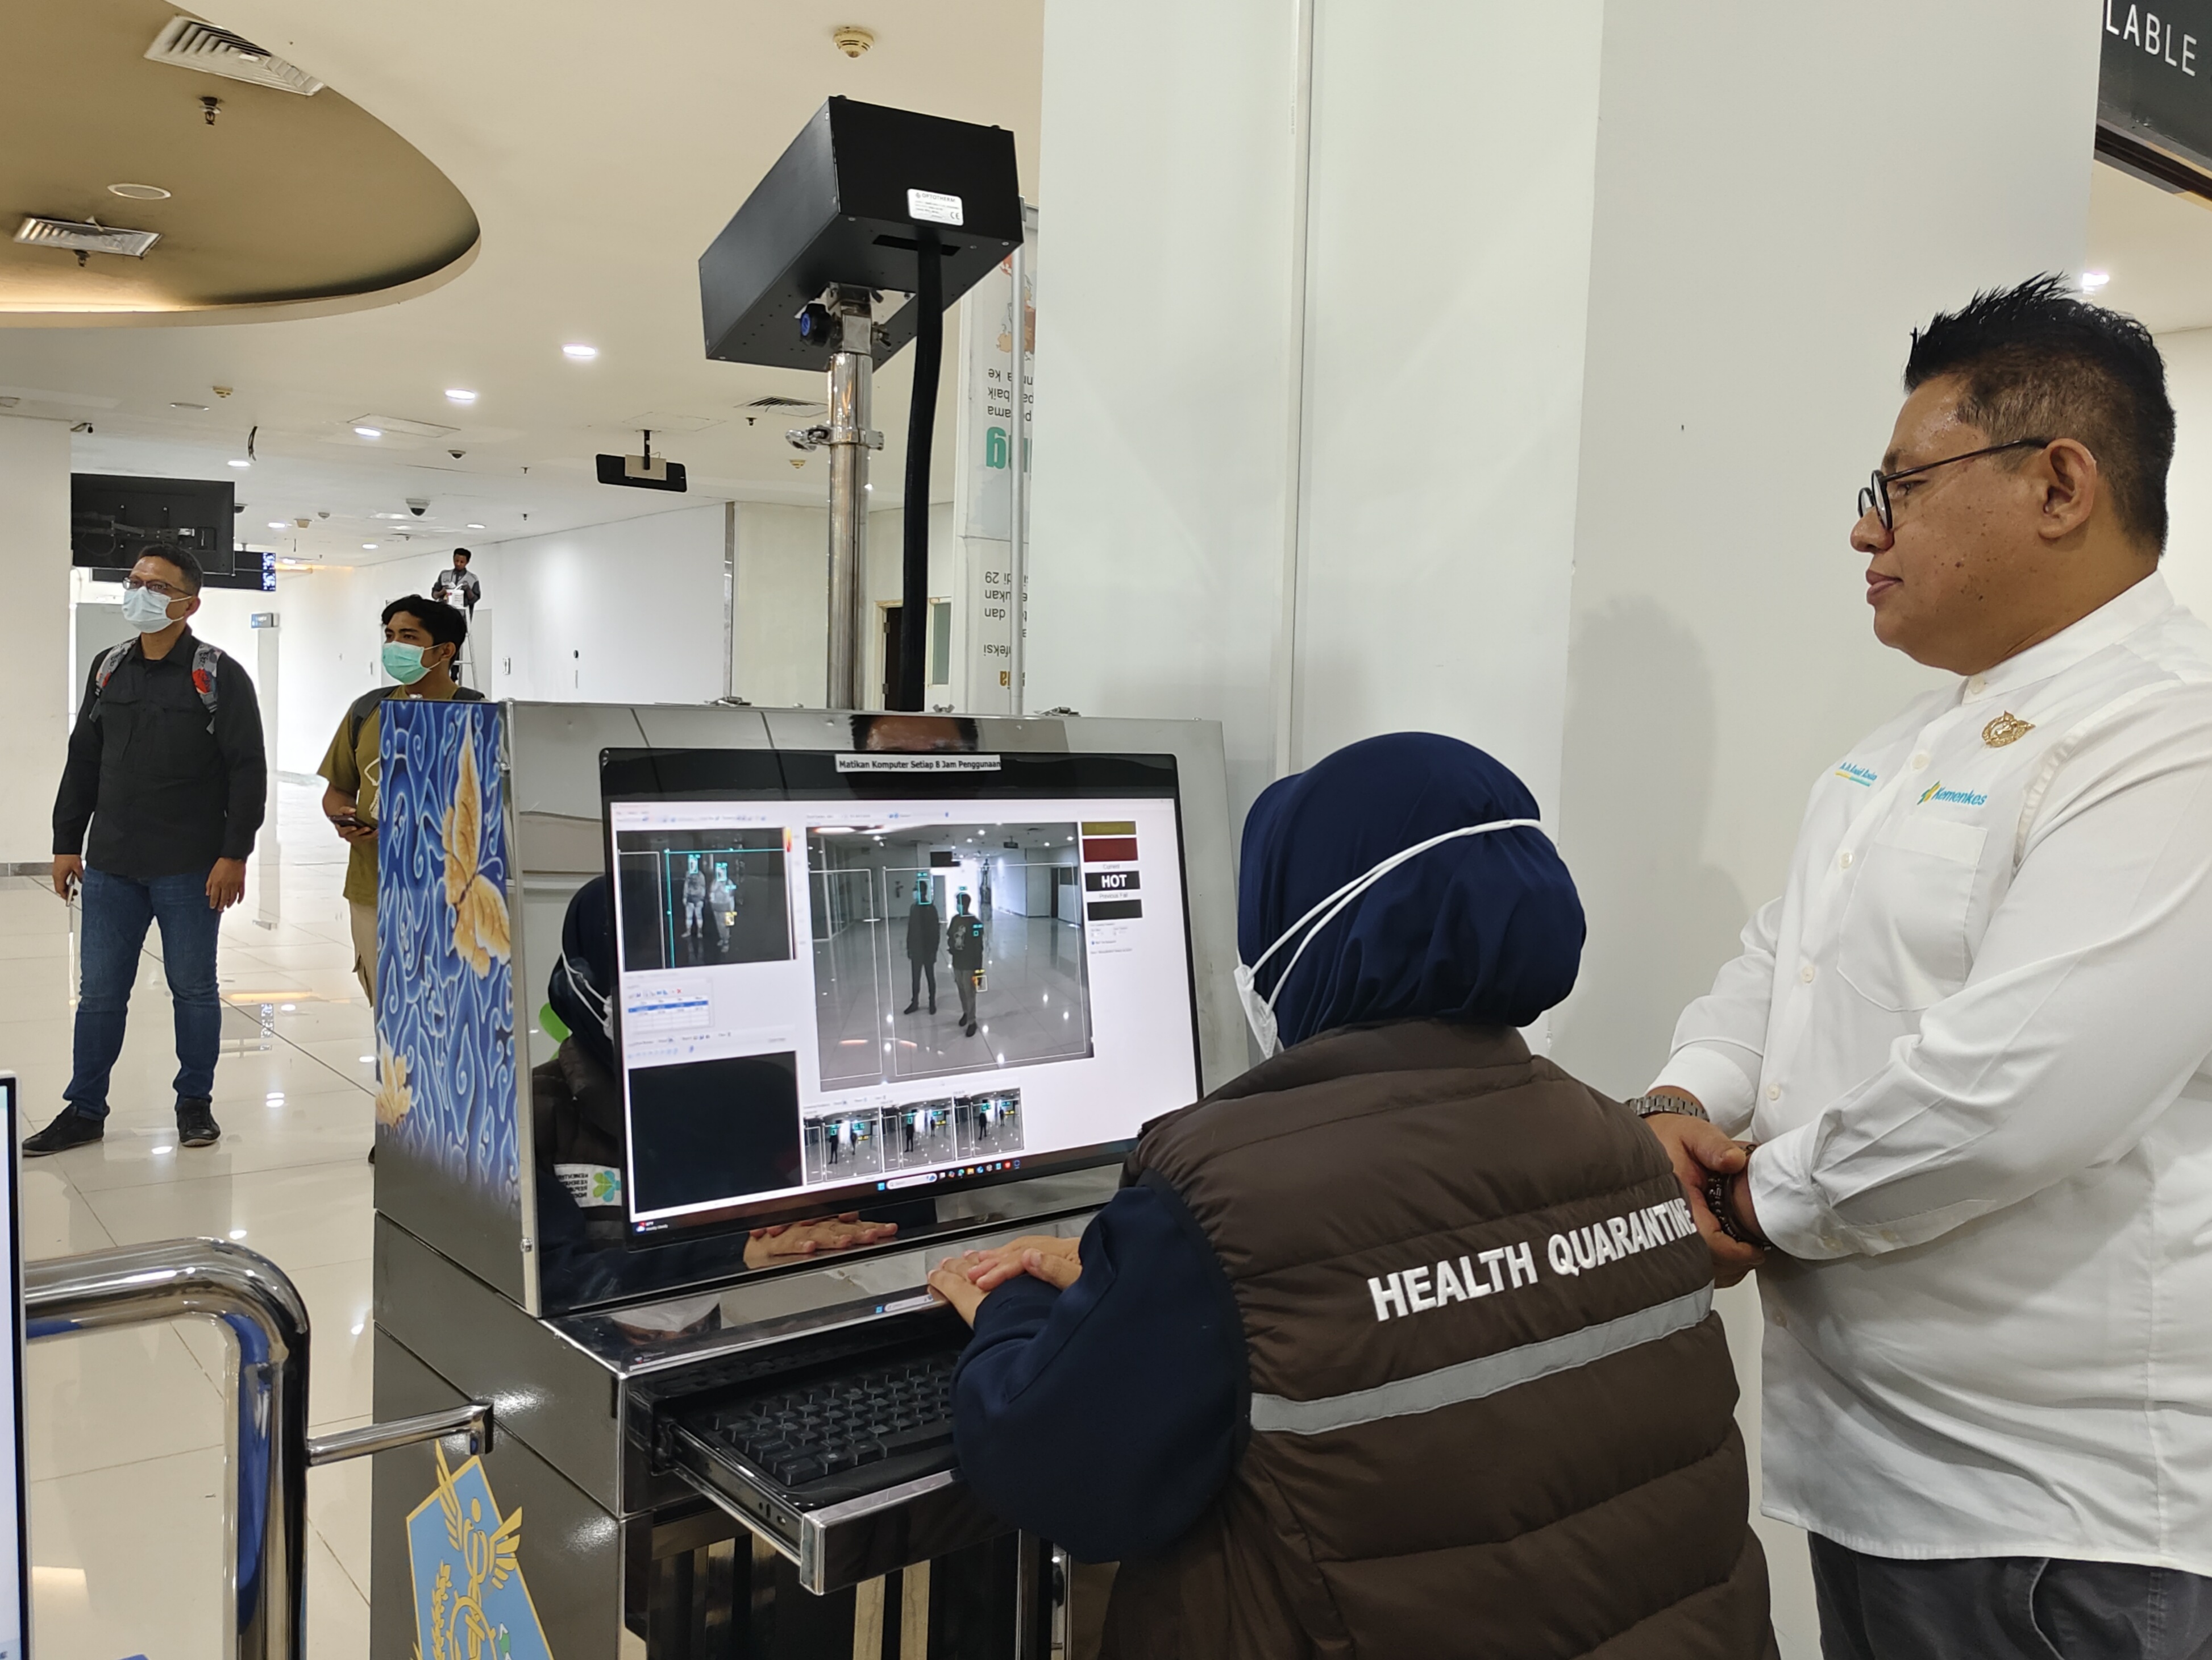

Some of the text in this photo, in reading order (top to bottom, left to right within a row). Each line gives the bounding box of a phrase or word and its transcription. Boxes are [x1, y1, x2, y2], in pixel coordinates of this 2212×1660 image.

[2106, 0, 2197, 77] LABLE
[988, 368, 1001, 382] ke
[987, 387, 1010, 402] baik
[985, 571, 1000, 583] 29
[984, 608, 1005, 620] dan
[984, 645, 1011, 657] feksi
[839, 760, 870, 769] Matikan
[872, 760, 909, 770] Komputer
[910, 760, 934, 770] Setiap
[959, 761, 1001, 770] Penggunaan
[1932, 787, 1988, 807] Kemenkes
[1101, 874, 1127, 889] HOT
[1367, 1197, 1698, 1322] HEALTH QUARANTINE
